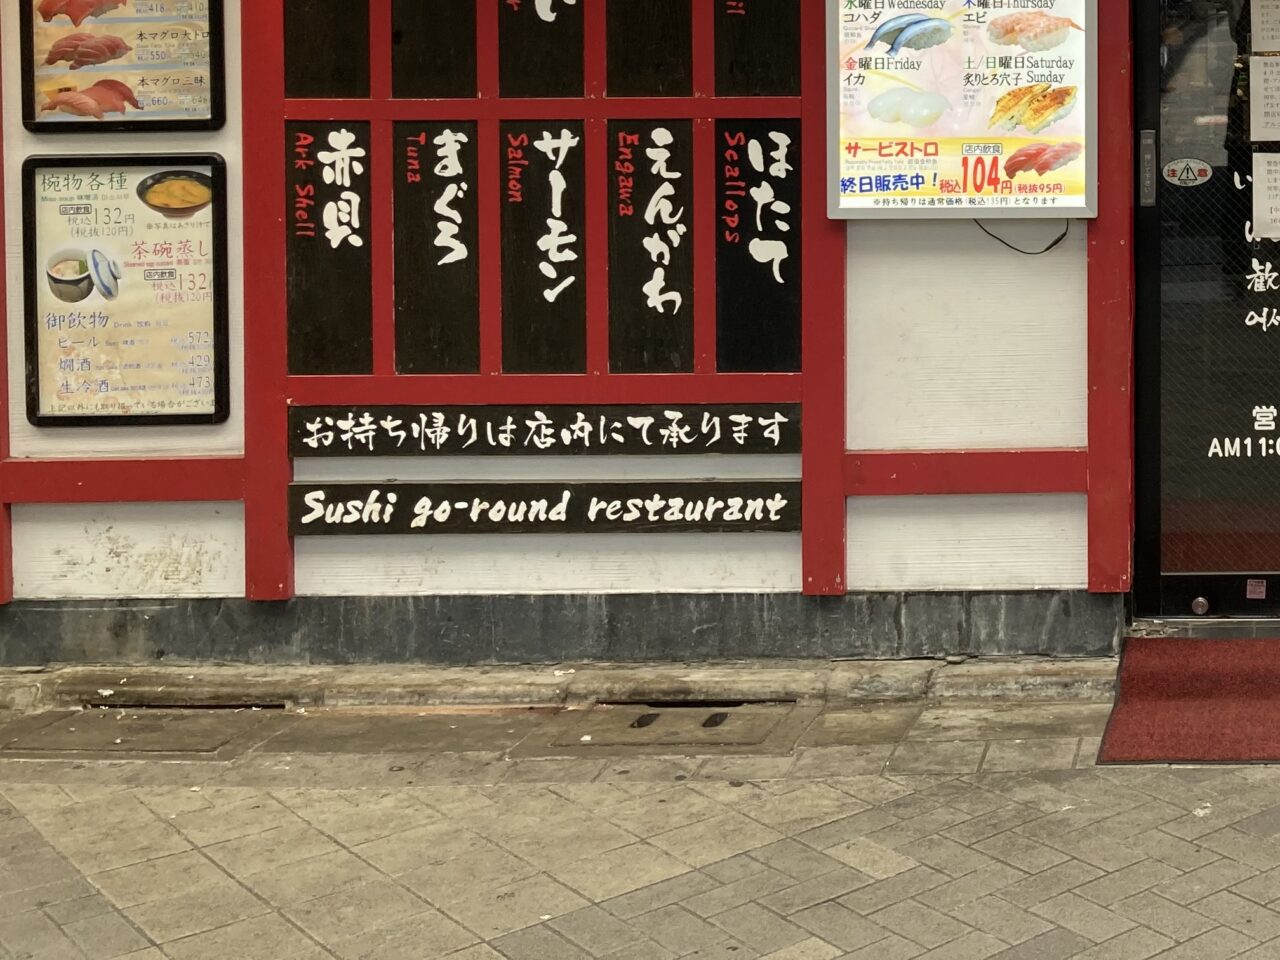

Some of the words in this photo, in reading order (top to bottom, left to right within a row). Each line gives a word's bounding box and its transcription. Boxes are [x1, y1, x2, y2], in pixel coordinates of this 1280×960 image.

[136, 29, 209, 42] 本マグロ大トロ
[843, 11, 881, 24] コハダ
[963, 11, 987, 24] エビ
[138, 75, 206, 88] 本マグロ三昧
[843, 73, 866, 86] イカ
[963, 72, 1023, 87] 炙りとろ穴子
[1026, 71, 1065, 84] Sunday
[294, 132, 315, 171] Ark
[406, 132, 426, 184] Tuna
[507, 132, 529, 203] Salmon
[845, 141, 939, 158] サービストロ
[965, 144, 1001, 154] 店内飲食
[41, 171, 128, 192] 椀物各種
[317, 128, 366, 249] 赤貝
[615, 132, 640, 217] Engawa
[721, 131, 746, 244] Scallops
[295, 184, 315, 237] Shell
[433, 128, 468, 266] まぐろ
[533, 128, 579, 302] サーモン
[747, 131, 793, 284] ほたて
[642, 127, 687, 315] えんがわ
[131, 239, 208, 260] 茶碗蒸し
[46, 311, 109, 330] 御飲物
[58, 336, 99, 348] ビール
[302, 410, 791, 451] お持ち帰りは店内にて承ります
[301, 490, 397, 523] Sushi
[410, 490, 573, 529] go-round
[587, 493, 788, 522] restaurant
